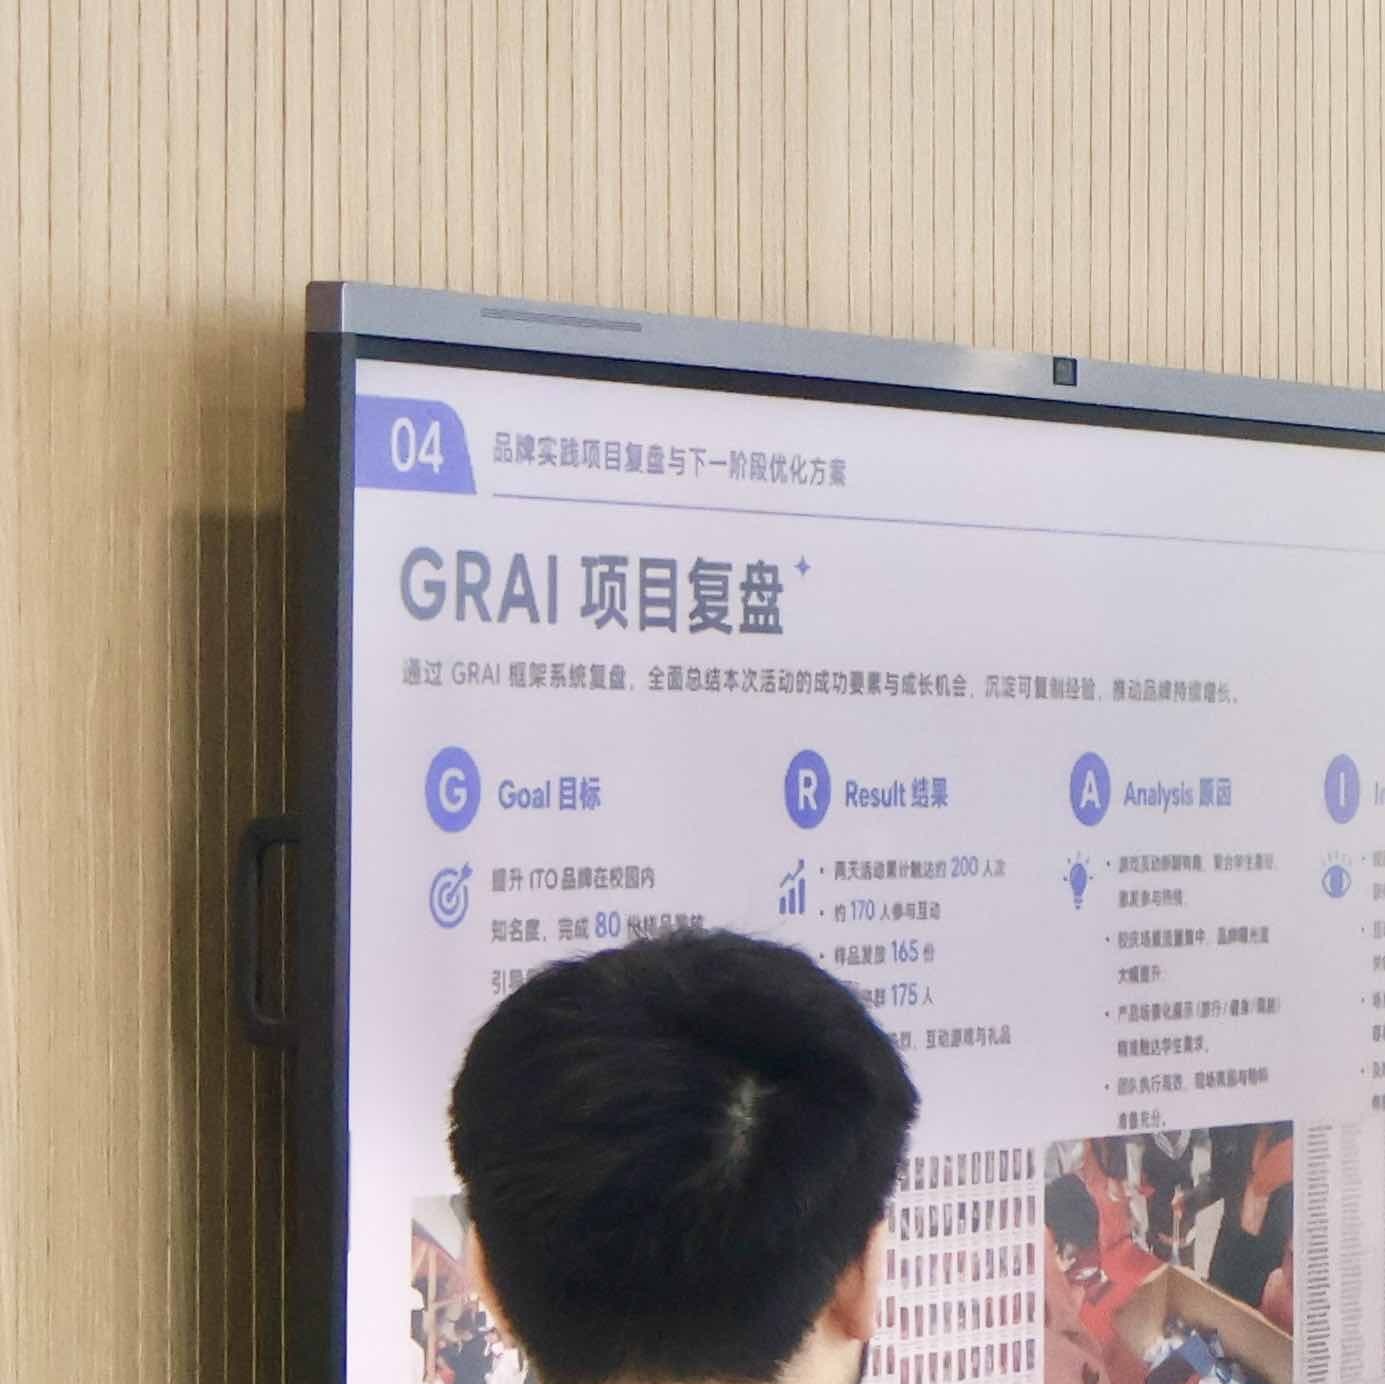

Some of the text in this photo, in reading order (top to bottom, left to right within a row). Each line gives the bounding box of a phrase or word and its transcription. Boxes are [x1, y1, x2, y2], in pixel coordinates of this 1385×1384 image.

[390, 417, 445, 473] 04
[493, 431, 848, 488] 品牌实践项目复盘与下一阶段优化方案
[401, 546, 785, 636] GRAI 项目复盘
[402, 658, 443, 687] 通过
[452, 663, 500, 686] GRAI
[439, 767, 468, 813] G
[499, 776, 602, 811] Goal 目标
[798, 768, 818, 810] R
[845, 776, 950, 808] Result 结果
[1079, 769, 1101, 809] A
[1123, 780, 1194, 814] Analysis
[491, 865, 656, 892] 提升 ITO 品牌在校园内
[951, 856, 978, 878] 200
[595, 911, 621, 939] 80
[851, 899, 876, 922] 170
[890, 940, 919, 963] 165
[890, 983, 918, 1006] 175
[923, 987, 936, 1006] 人
